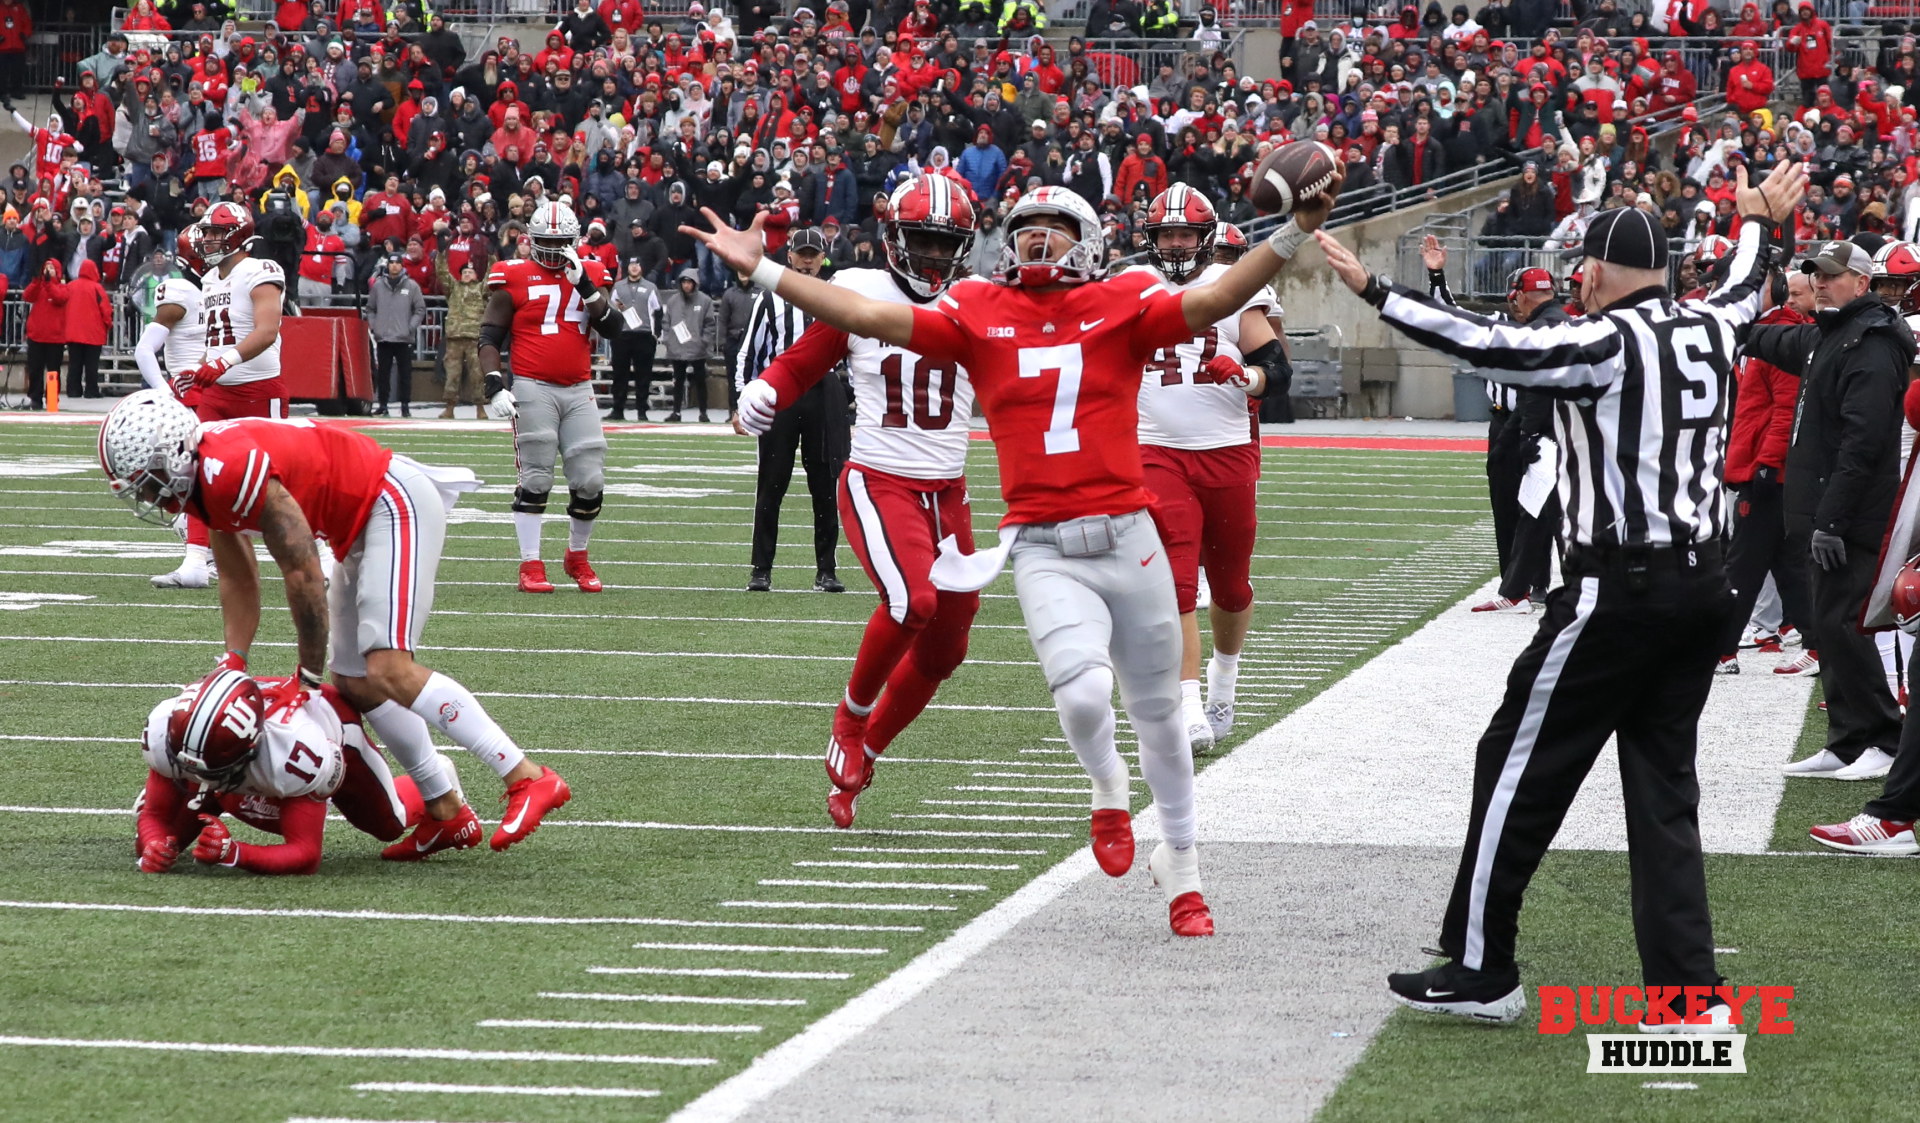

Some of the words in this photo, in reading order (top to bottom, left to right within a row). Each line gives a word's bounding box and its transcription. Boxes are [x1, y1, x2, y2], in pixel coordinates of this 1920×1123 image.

[198, 141, 217, 161] 16
[156, 284, 166, 301] 9
[527, 284, 590, 335] 74
[205, 308, 236, 348] 41
[880, 353, 958, 430] 10
[1670, 324, 1719, 420] S
[1018, 342, 1084, 455] 7
[203, 456, 225, 486] 4
[1687, 550, 1697, 567] S
[285, 740, 323, 784] 17
